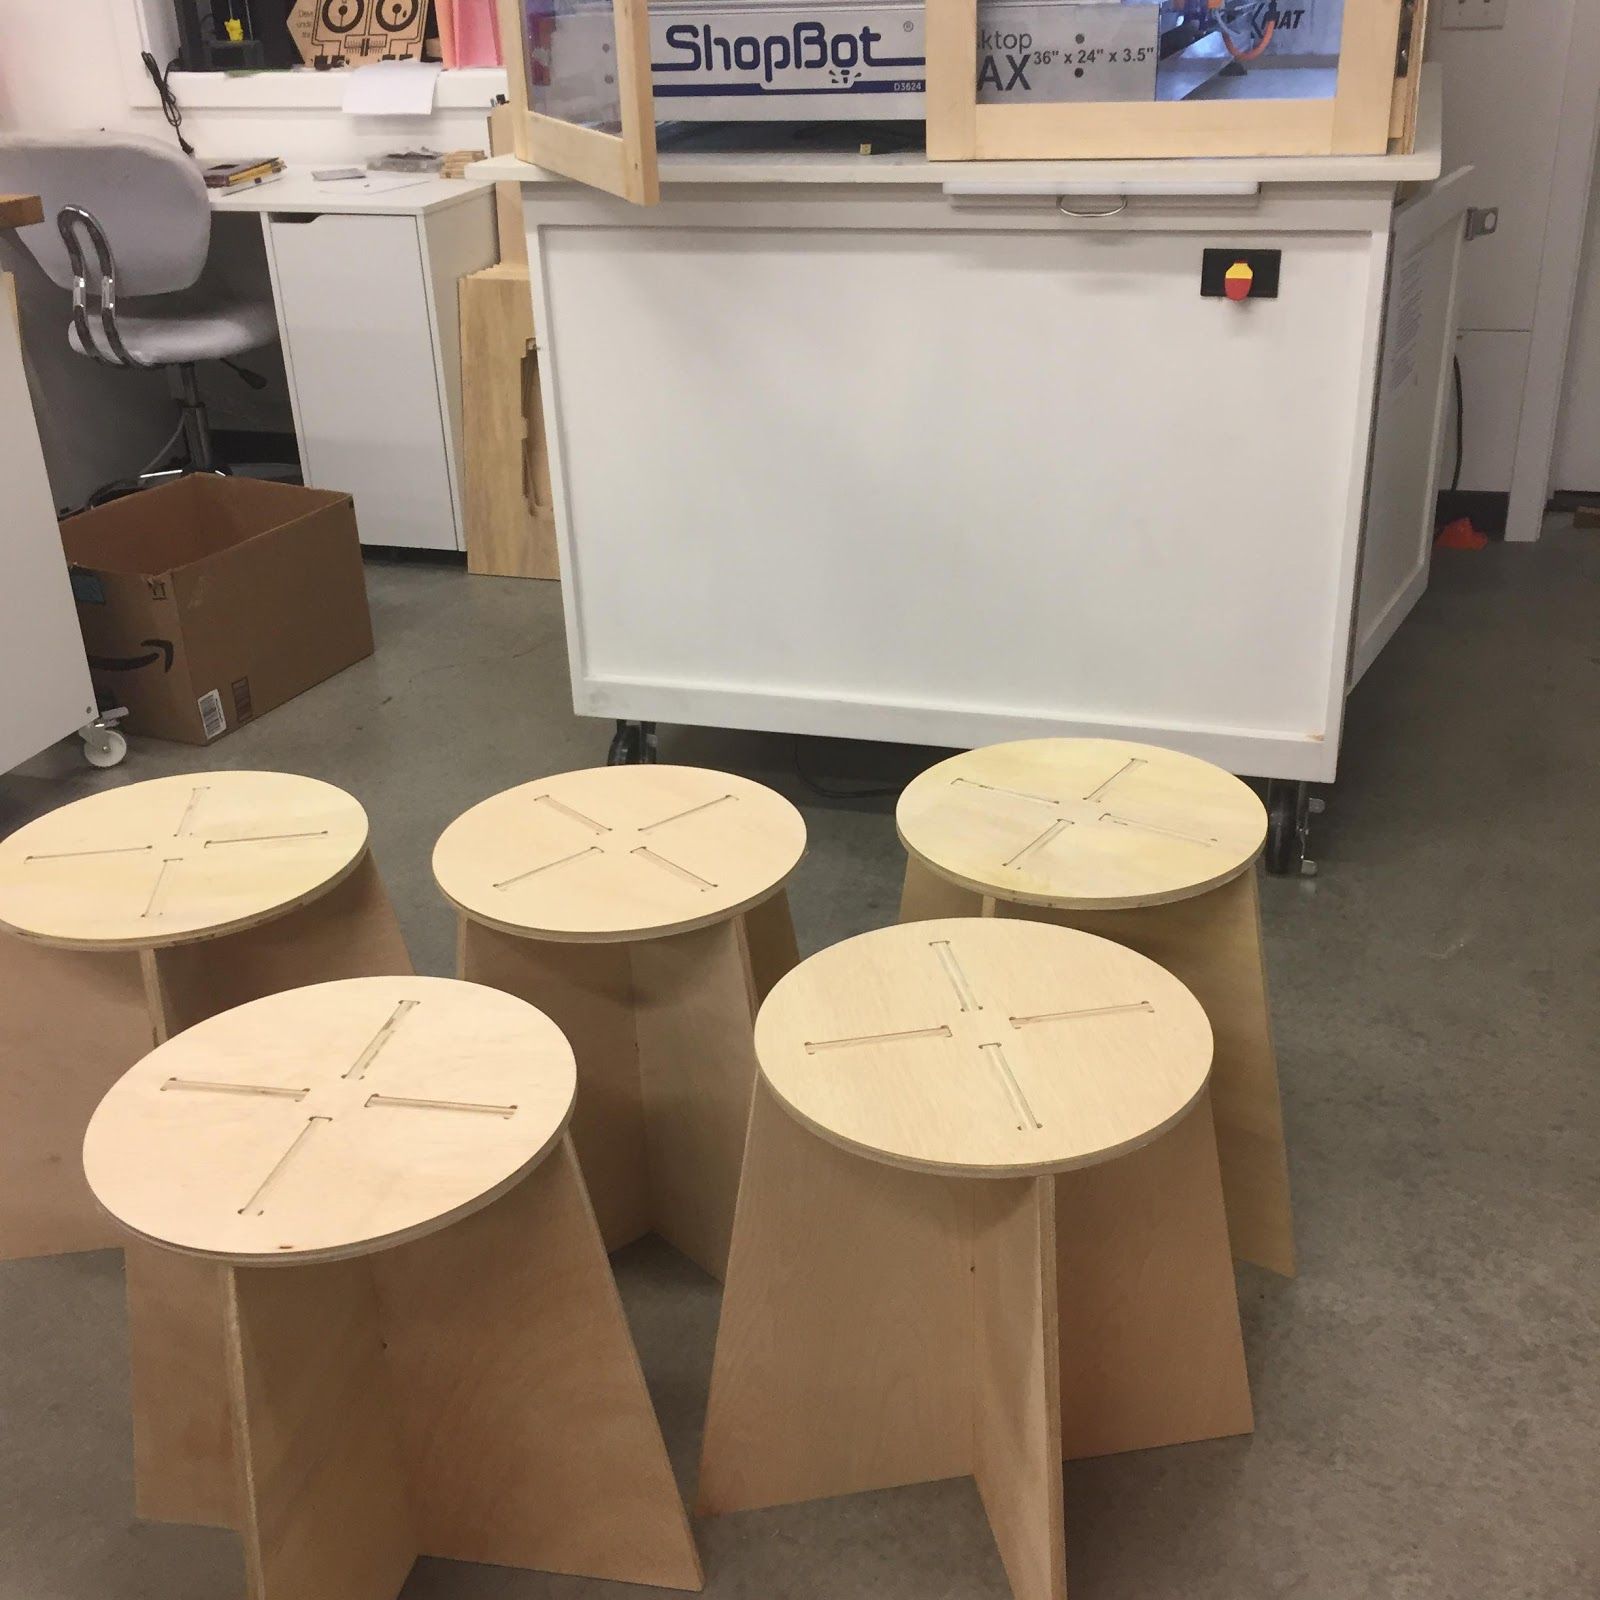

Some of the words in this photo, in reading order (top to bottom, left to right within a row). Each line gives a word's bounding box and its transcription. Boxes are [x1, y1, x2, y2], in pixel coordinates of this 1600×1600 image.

[666, 21, 882, 83] ShopBot
[977, 29, 1033, 55] ktop
[1033, 50, 1060, 65] 36"
[1064, 52, 1073, 64] x
[1078, 49, 1104, 64] 24"
[1109, 51, 1117, 63] x
[1122, 46, 1155, 62] 3.5"
[893, 82, 922, 91] D3624
